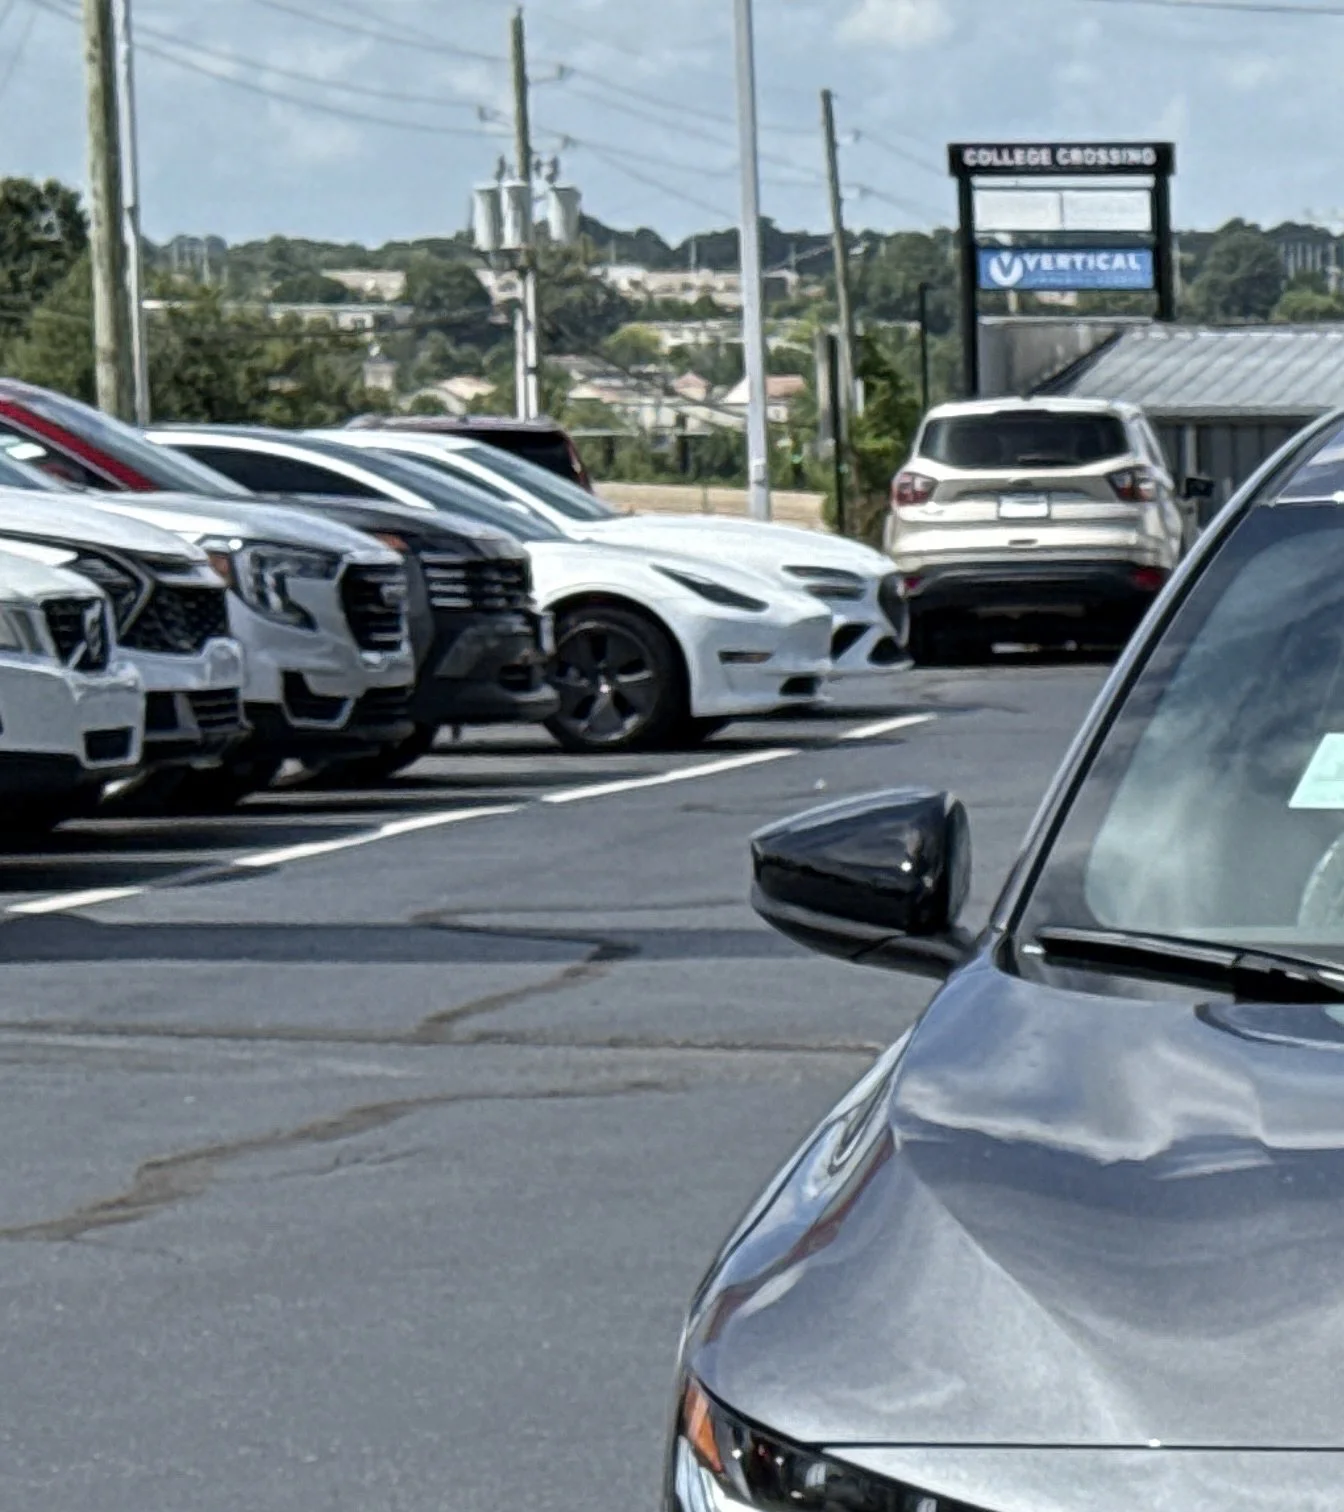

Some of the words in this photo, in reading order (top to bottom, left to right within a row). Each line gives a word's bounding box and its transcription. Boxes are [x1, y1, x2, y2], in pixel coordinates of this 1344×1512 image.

[963, 147, 1052, 166] COLLEGE
[1056, 147, 1157, 166] CROSSING
[1023, 252, 1141, 271] VERTICAL
